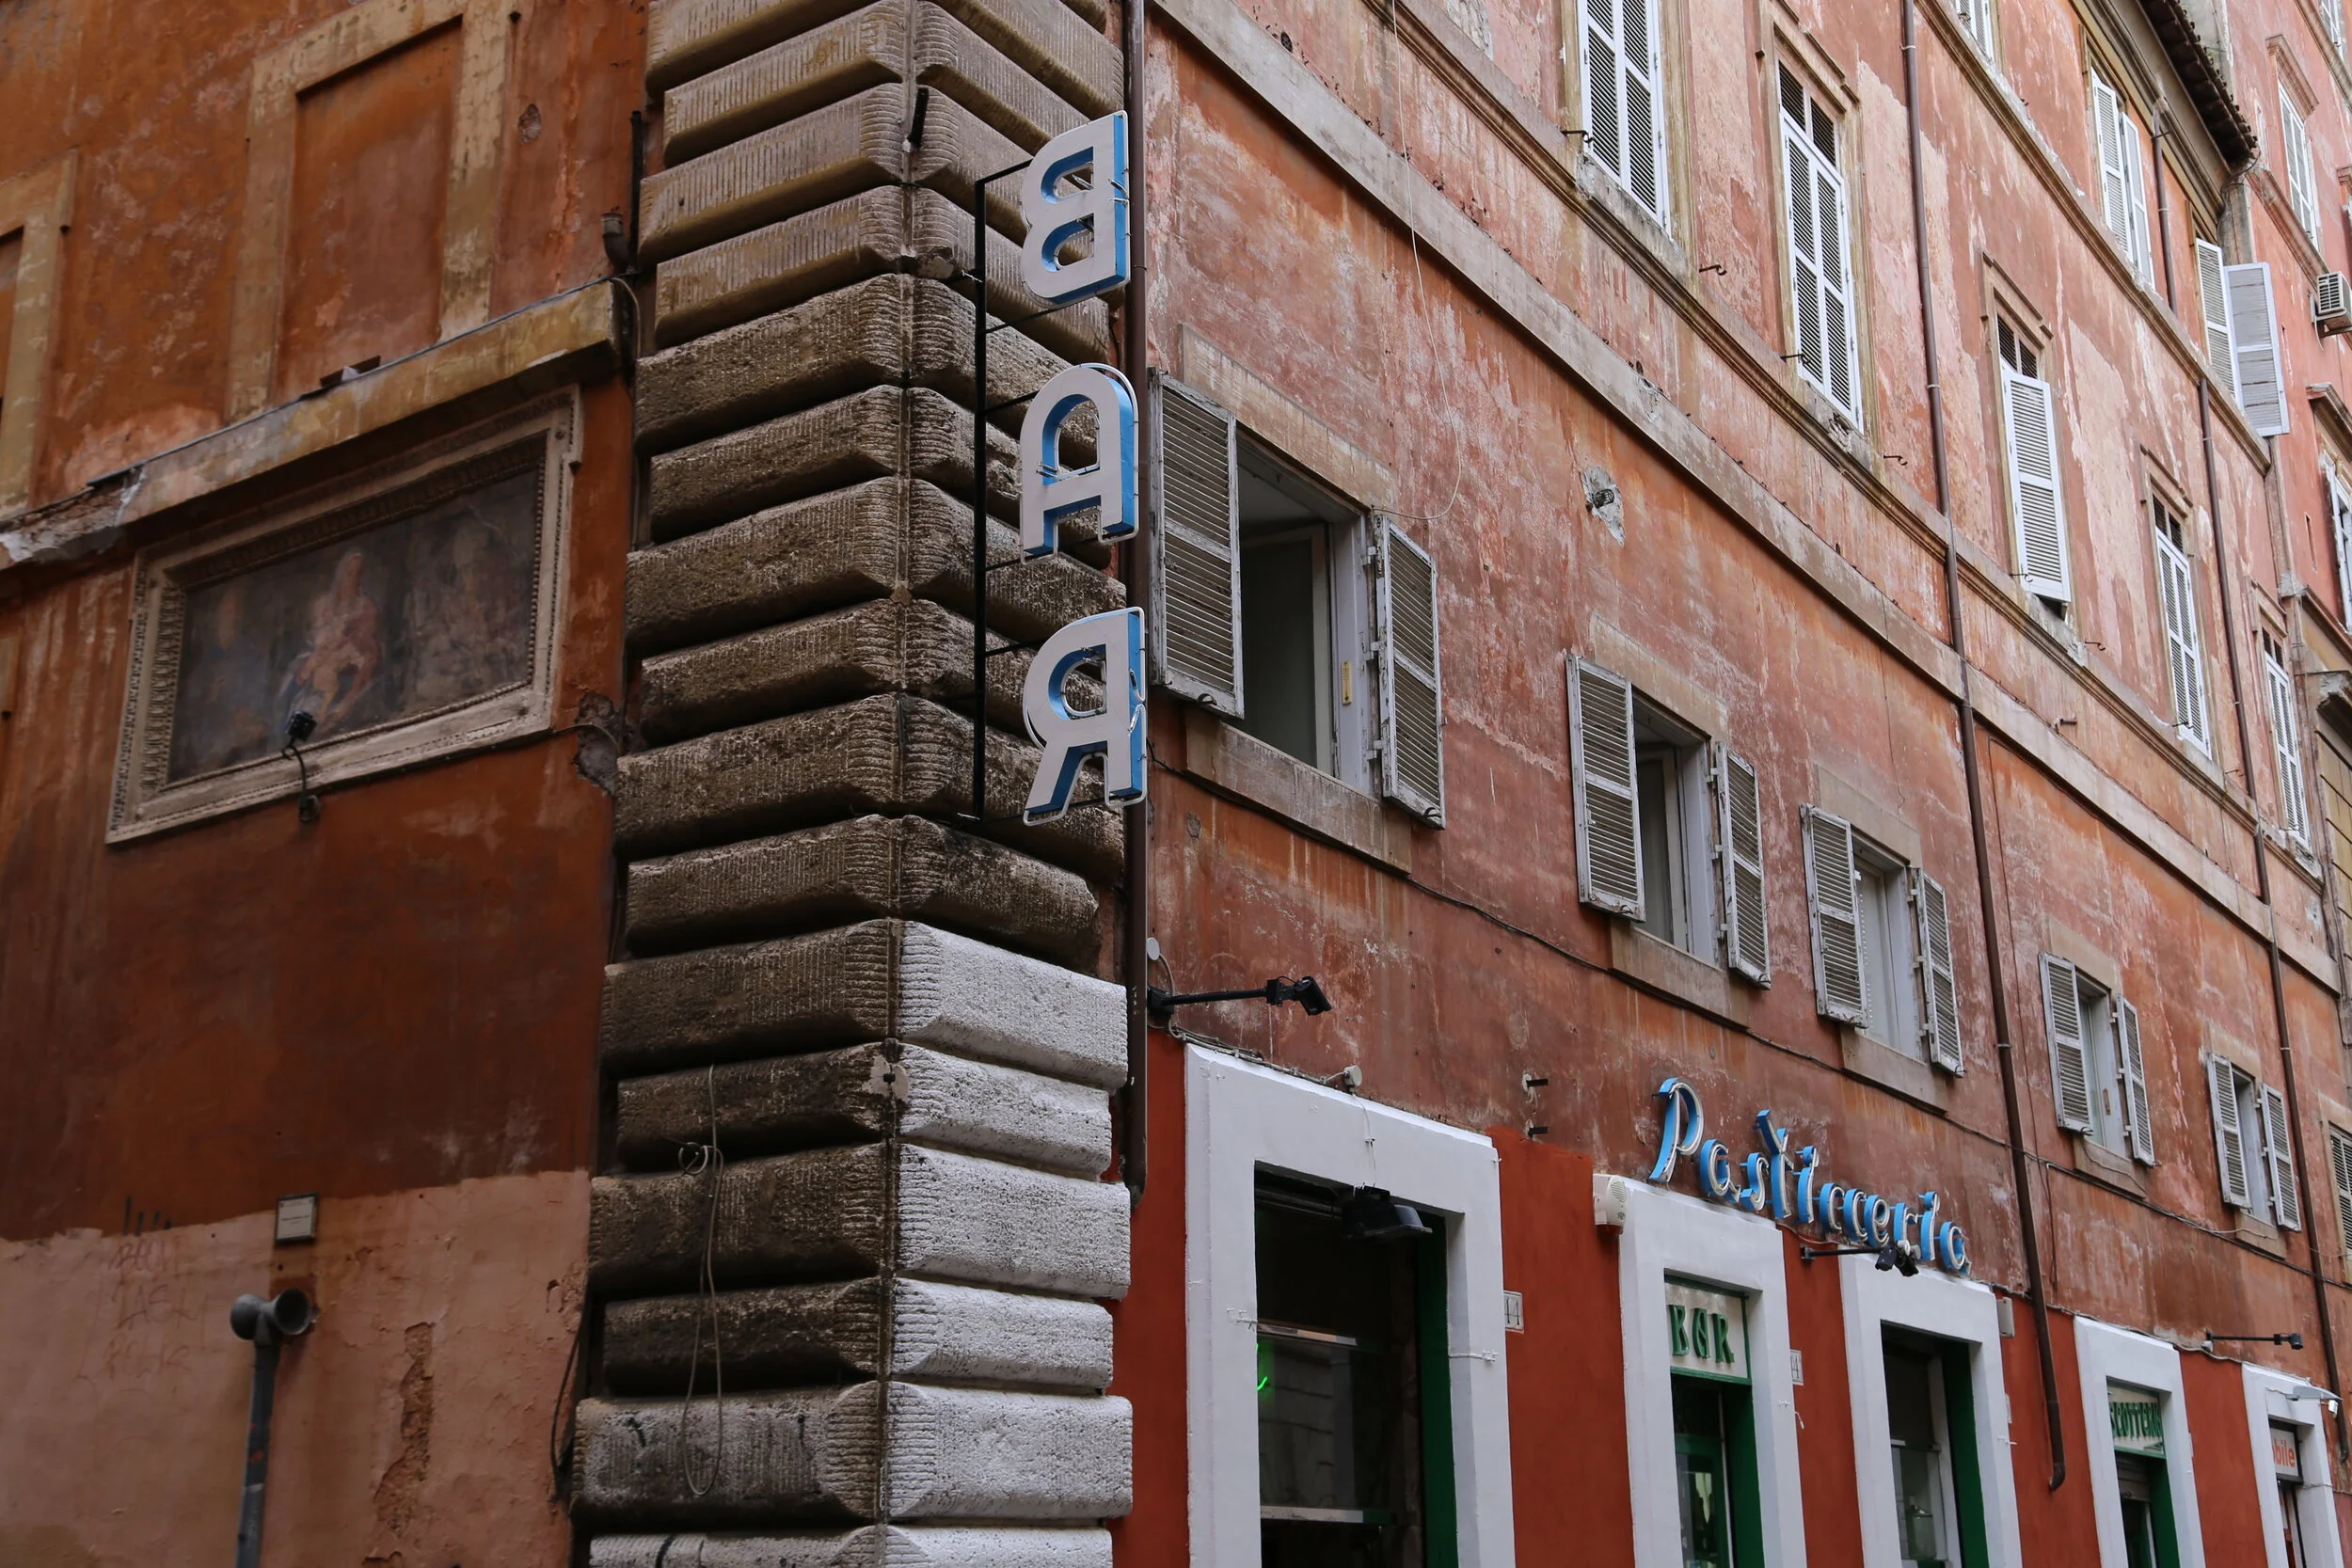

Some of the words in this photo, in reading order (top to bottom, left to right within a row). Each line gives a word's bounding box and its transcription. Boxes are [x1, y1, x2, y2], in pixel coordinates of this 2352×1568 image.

[1649, 1077, 1972, 1276] Pasticceria
[1668, 1304, 1735, 1363] BAR
[2272, 1437, 2296, 1467] bile
